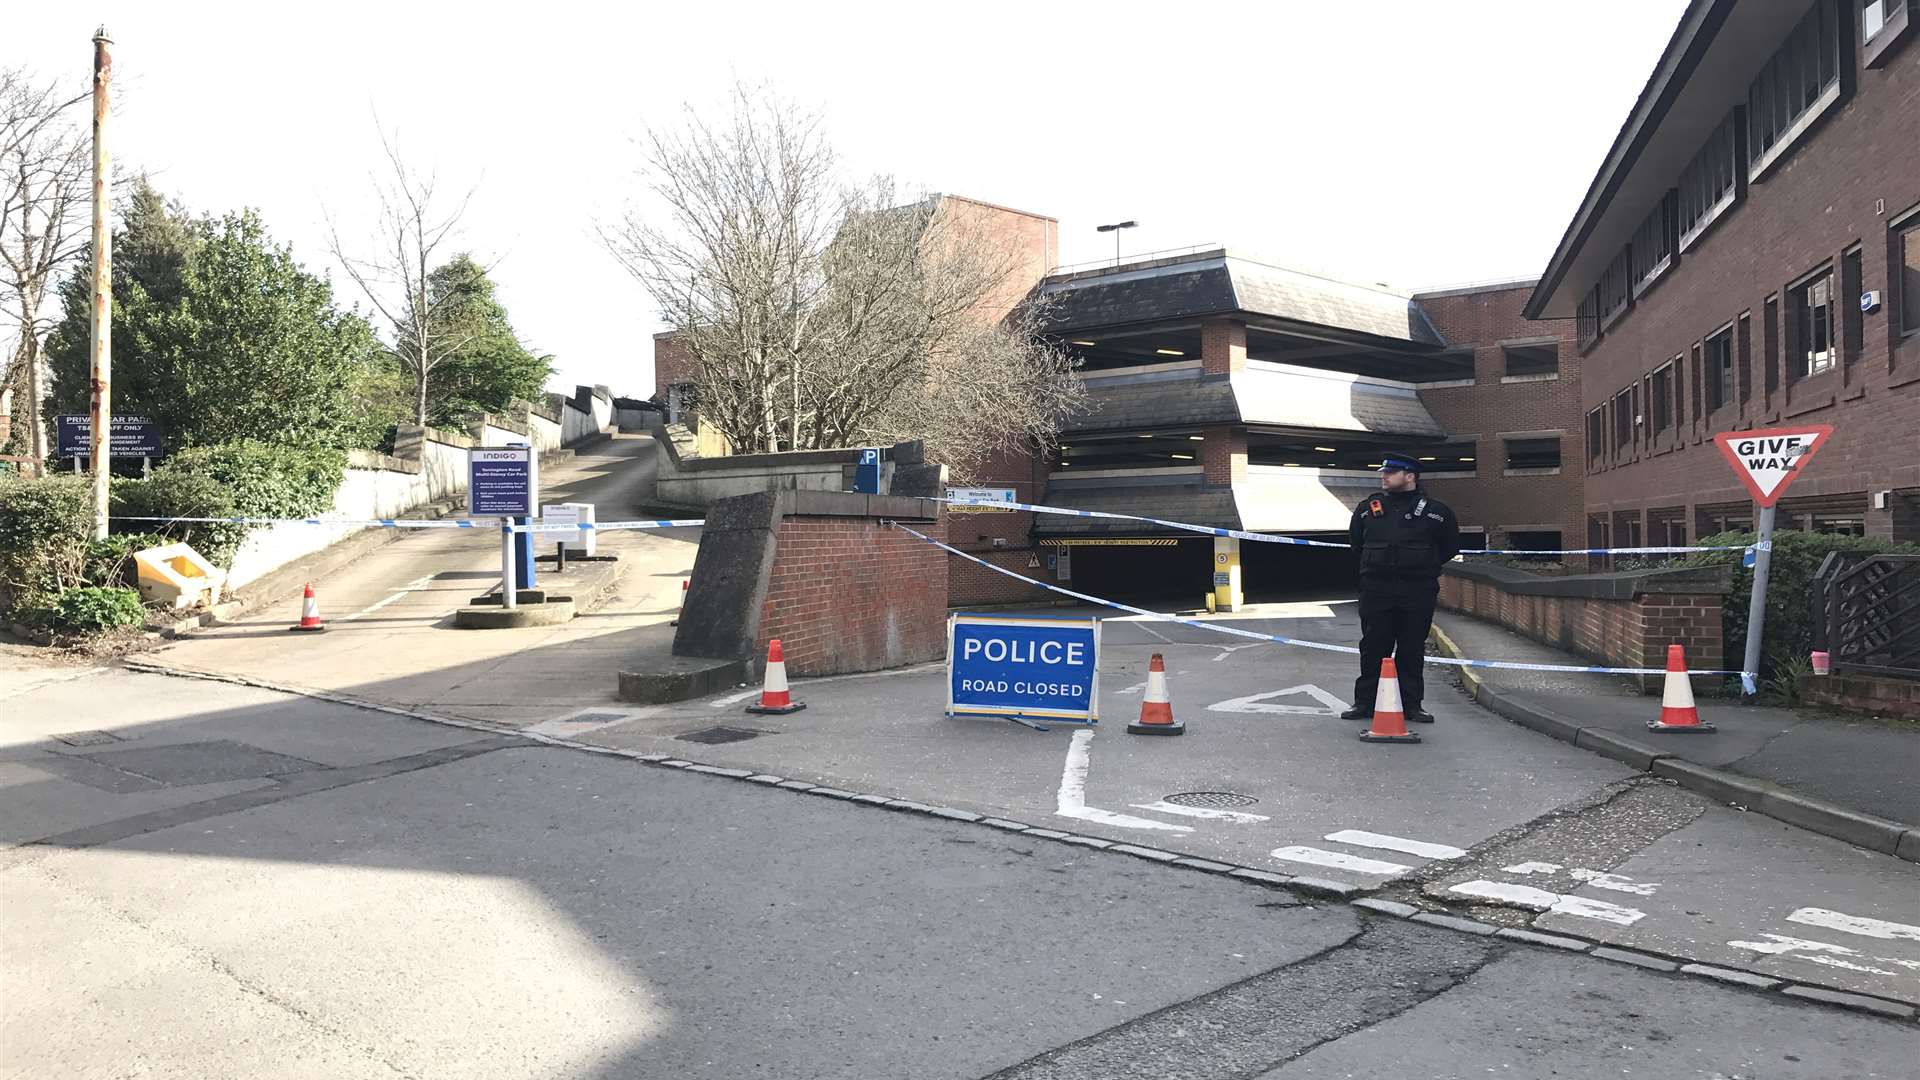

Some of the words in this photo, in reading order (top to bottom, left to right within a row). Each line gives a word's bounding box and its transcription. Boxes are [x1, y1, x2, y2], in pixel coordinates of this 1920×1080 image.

[1738, 437, 1801, 456] GIVE
[865, 450, 877, 465] P
[1749, 457, 1793, 470] WAY
[964, 638, 1084, 665] POLICE
[962, 679, 1008, 693] ROAD
[1014, 681, 1083, 697] CLOSED
